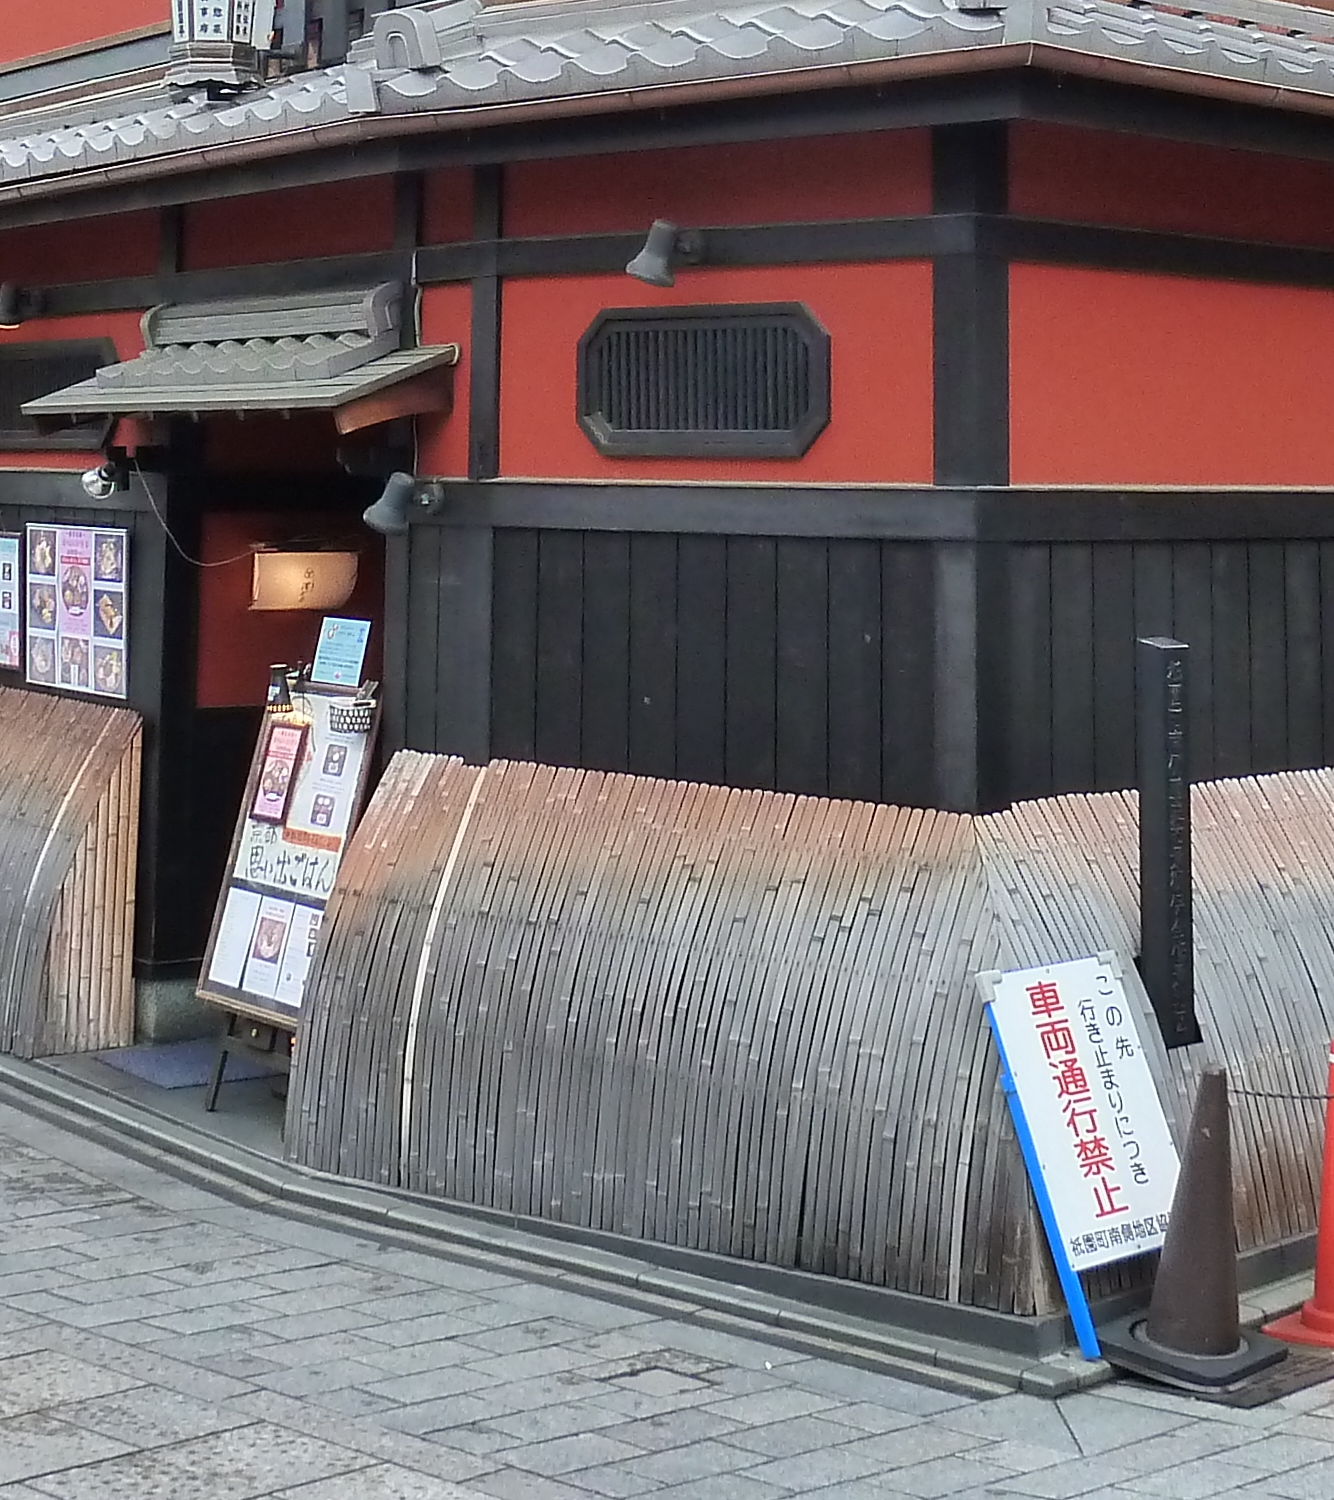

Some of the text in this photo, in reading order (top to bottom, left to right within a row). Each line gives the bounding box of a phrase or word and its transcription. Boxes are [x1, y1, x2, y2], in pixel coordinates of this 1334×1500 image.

[1025, 980, 1130, 1219] 車両通行禁止
[1077, 998, 1149, 1186] 行き止まりにつき
[1094, 974, 1135, 1059] この先
